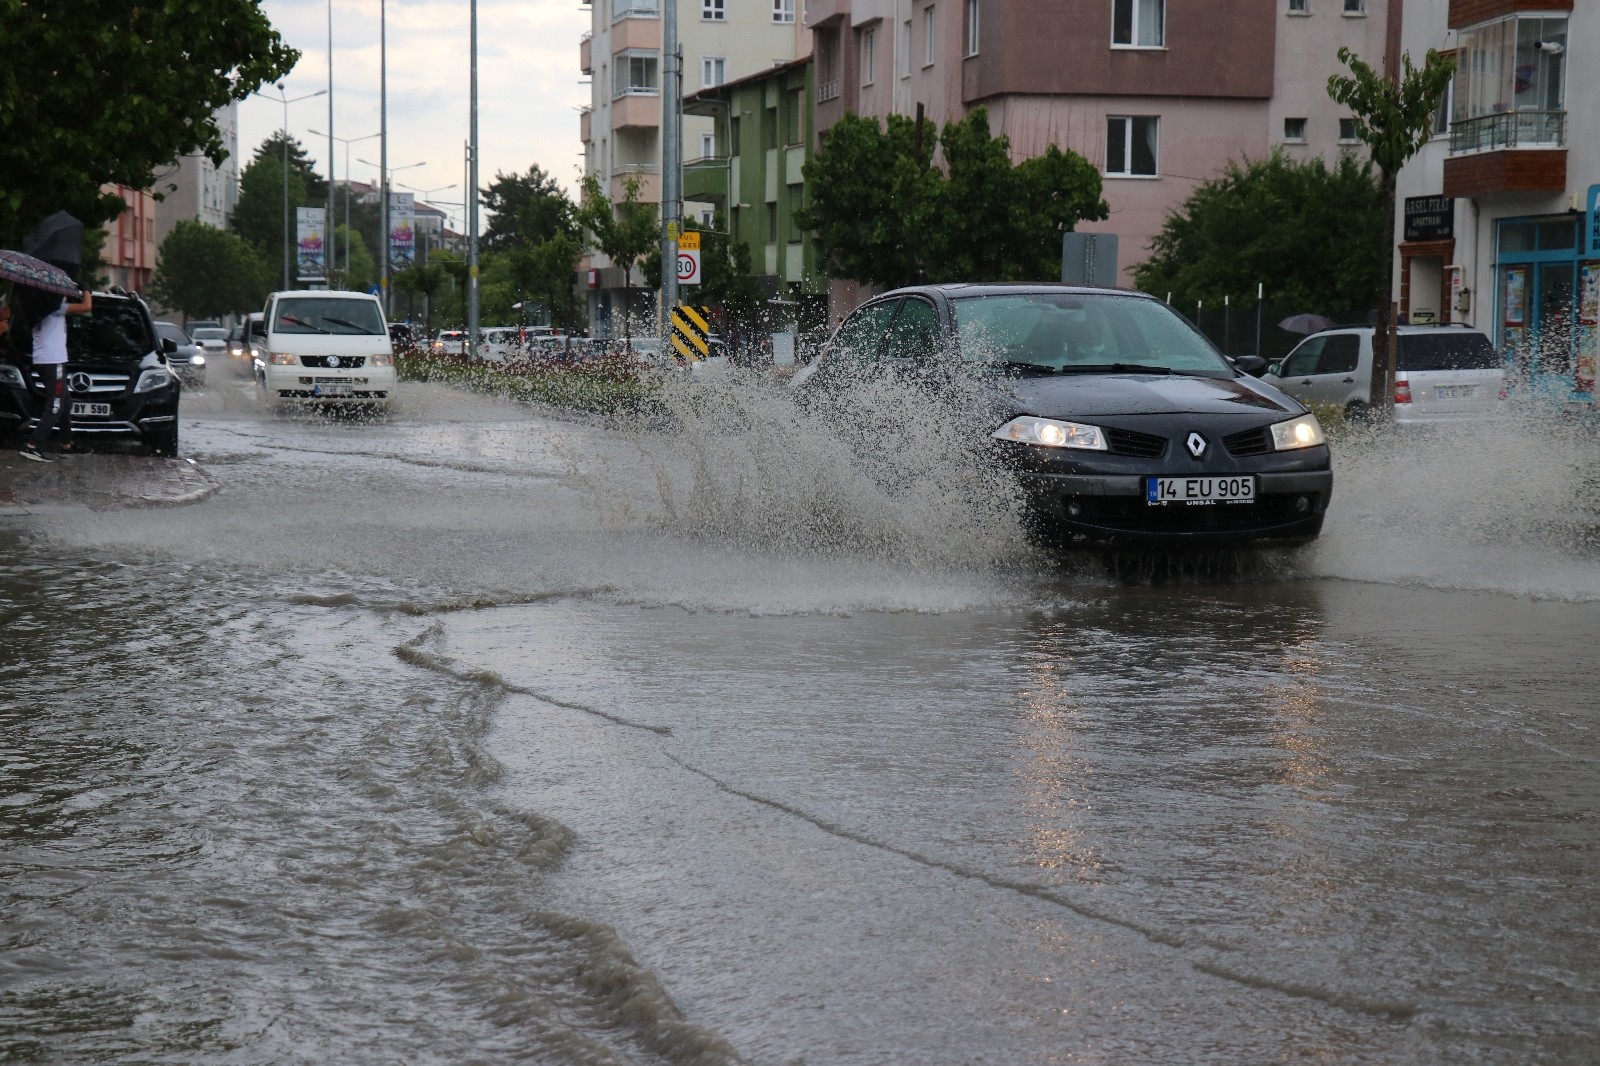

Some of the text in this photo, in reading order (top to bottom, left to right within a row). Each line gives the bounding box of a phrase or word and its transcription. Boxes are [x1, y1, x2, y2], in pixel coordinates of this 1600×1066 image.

[677, 261, 692, 273] 30
[91, 404, 108, 414] 590
[1158, 479, 1251, 498] 14 EU 905
